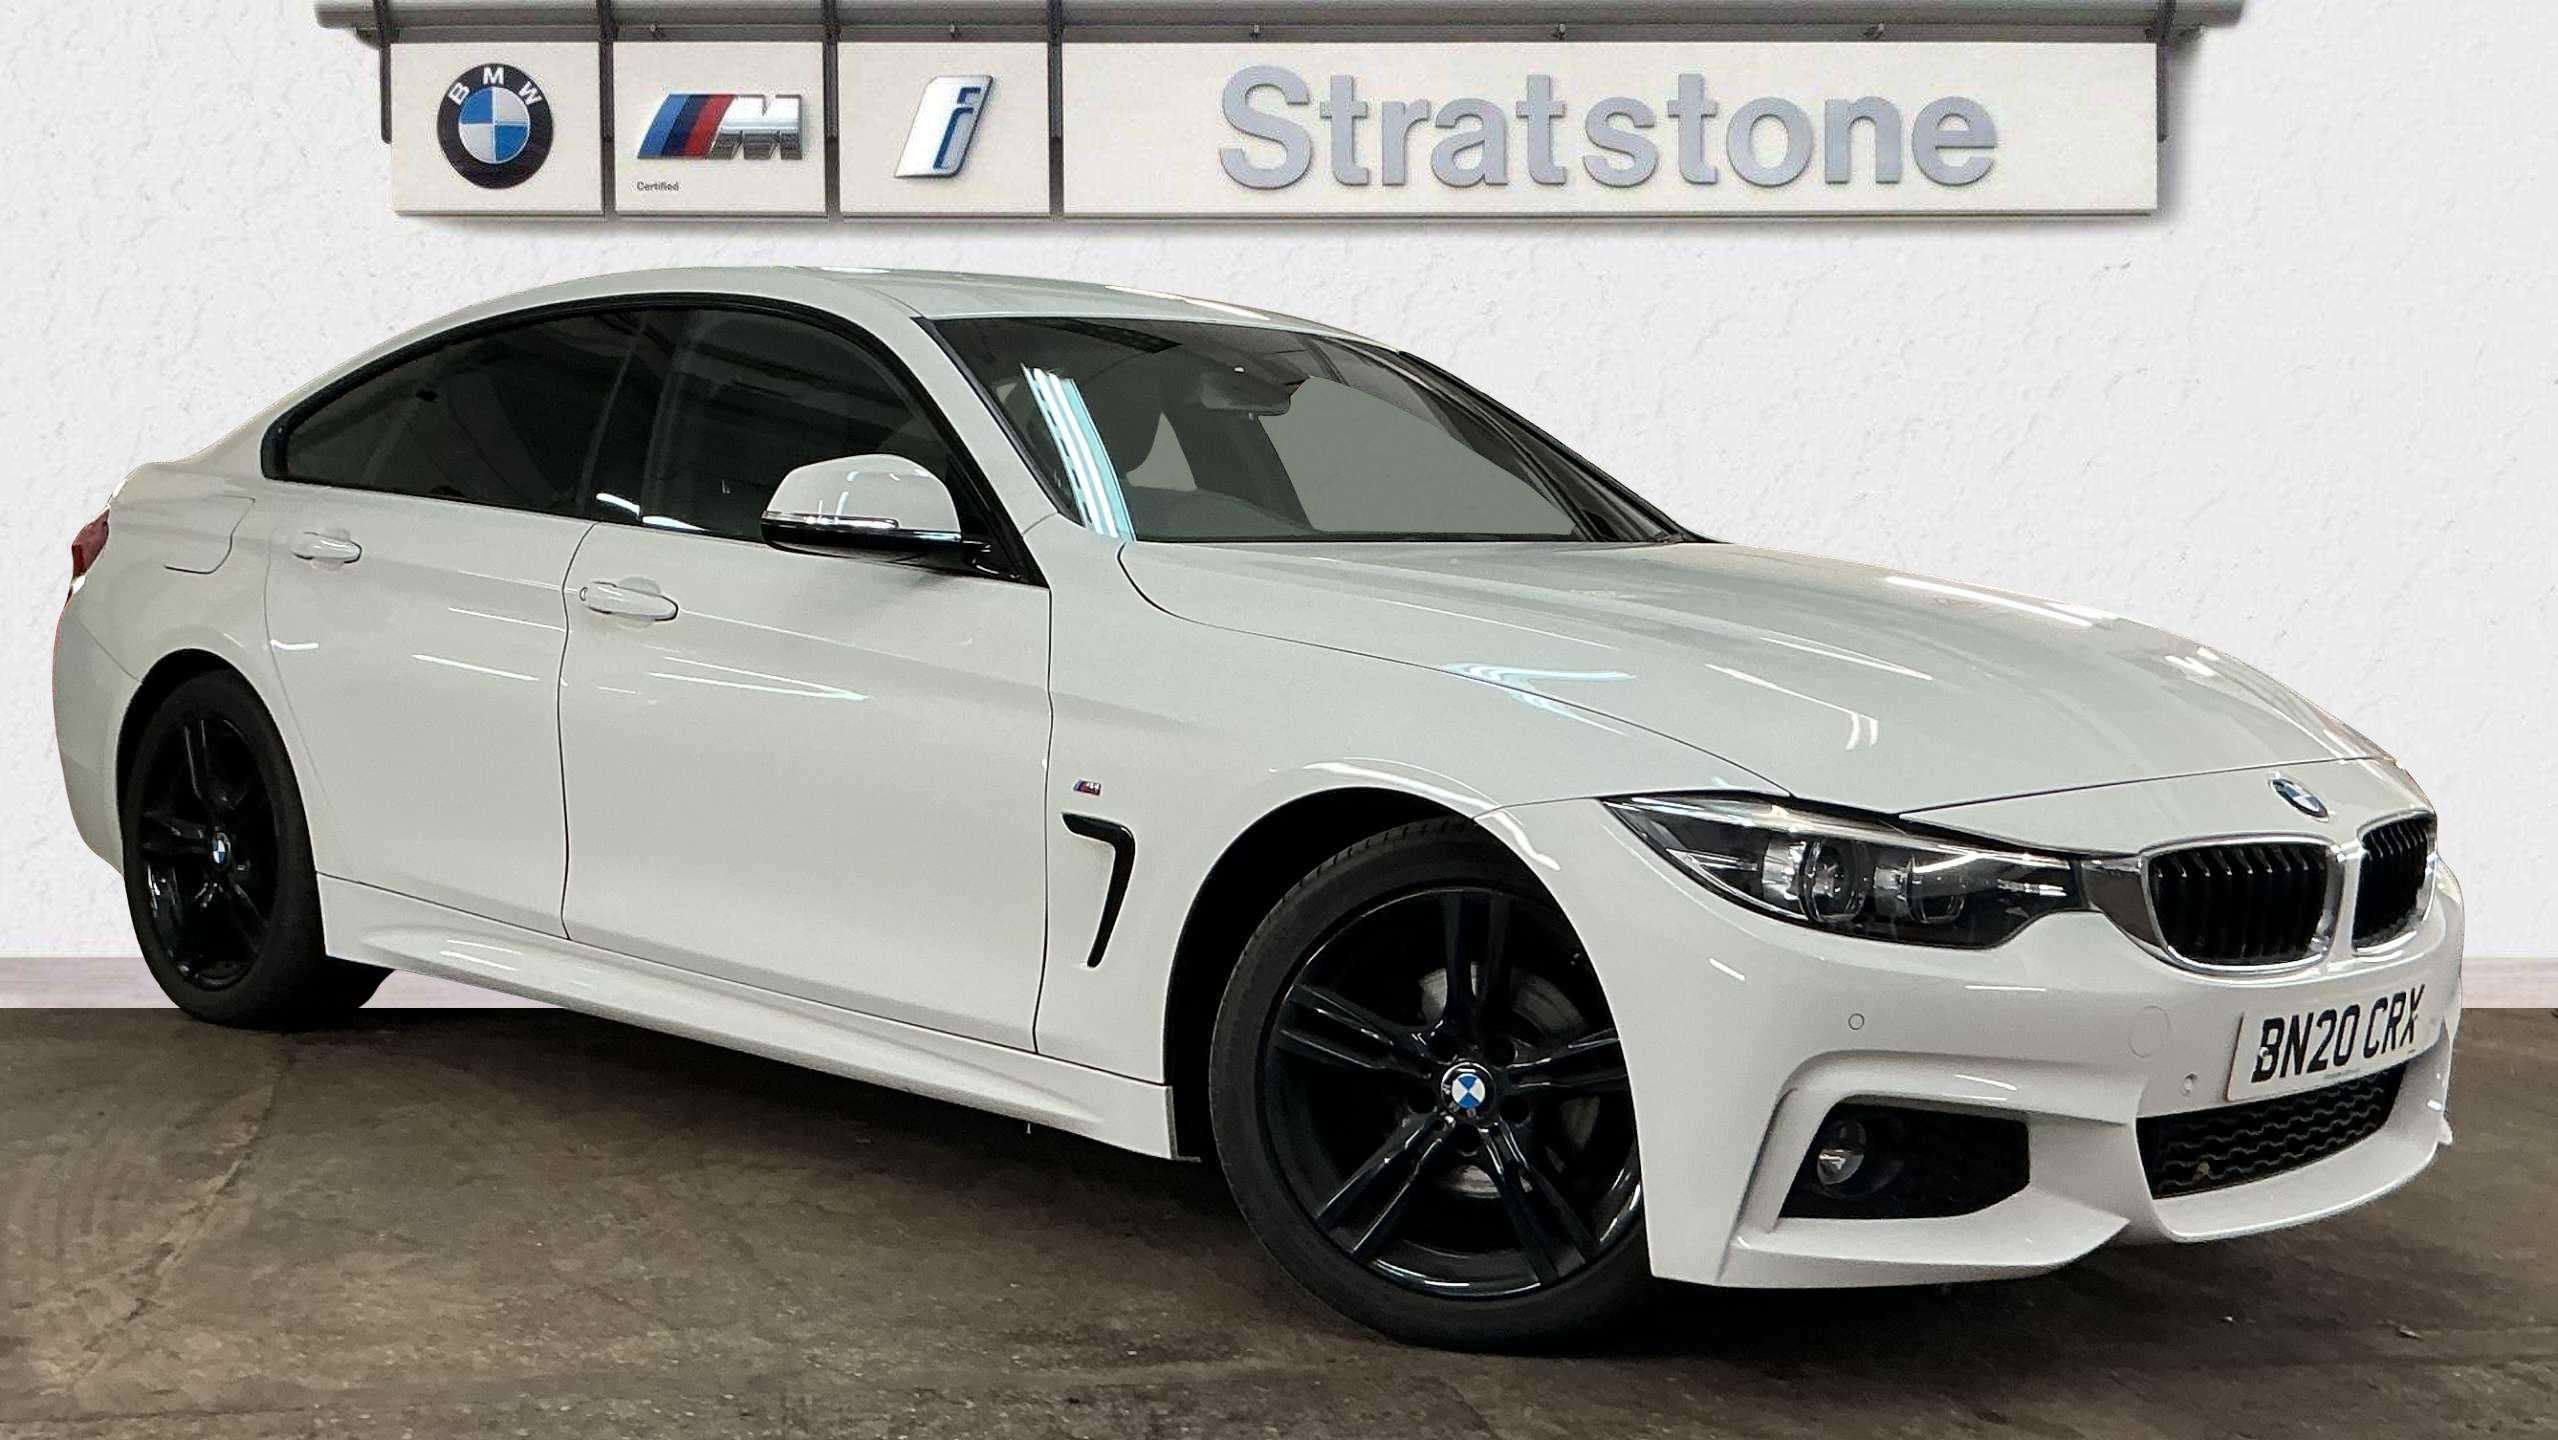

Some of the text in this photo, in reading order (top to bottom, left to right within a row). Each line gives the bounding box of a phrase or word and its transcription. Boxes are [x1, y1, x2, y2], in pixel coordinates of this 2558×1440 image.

[447, 66, 543, 106] BMW
[1219, 64, 1998, 190] Stratstone
[636, 181, 680, 192] Certified
[2251, 984, 2425, 1083] BN20 CRX
